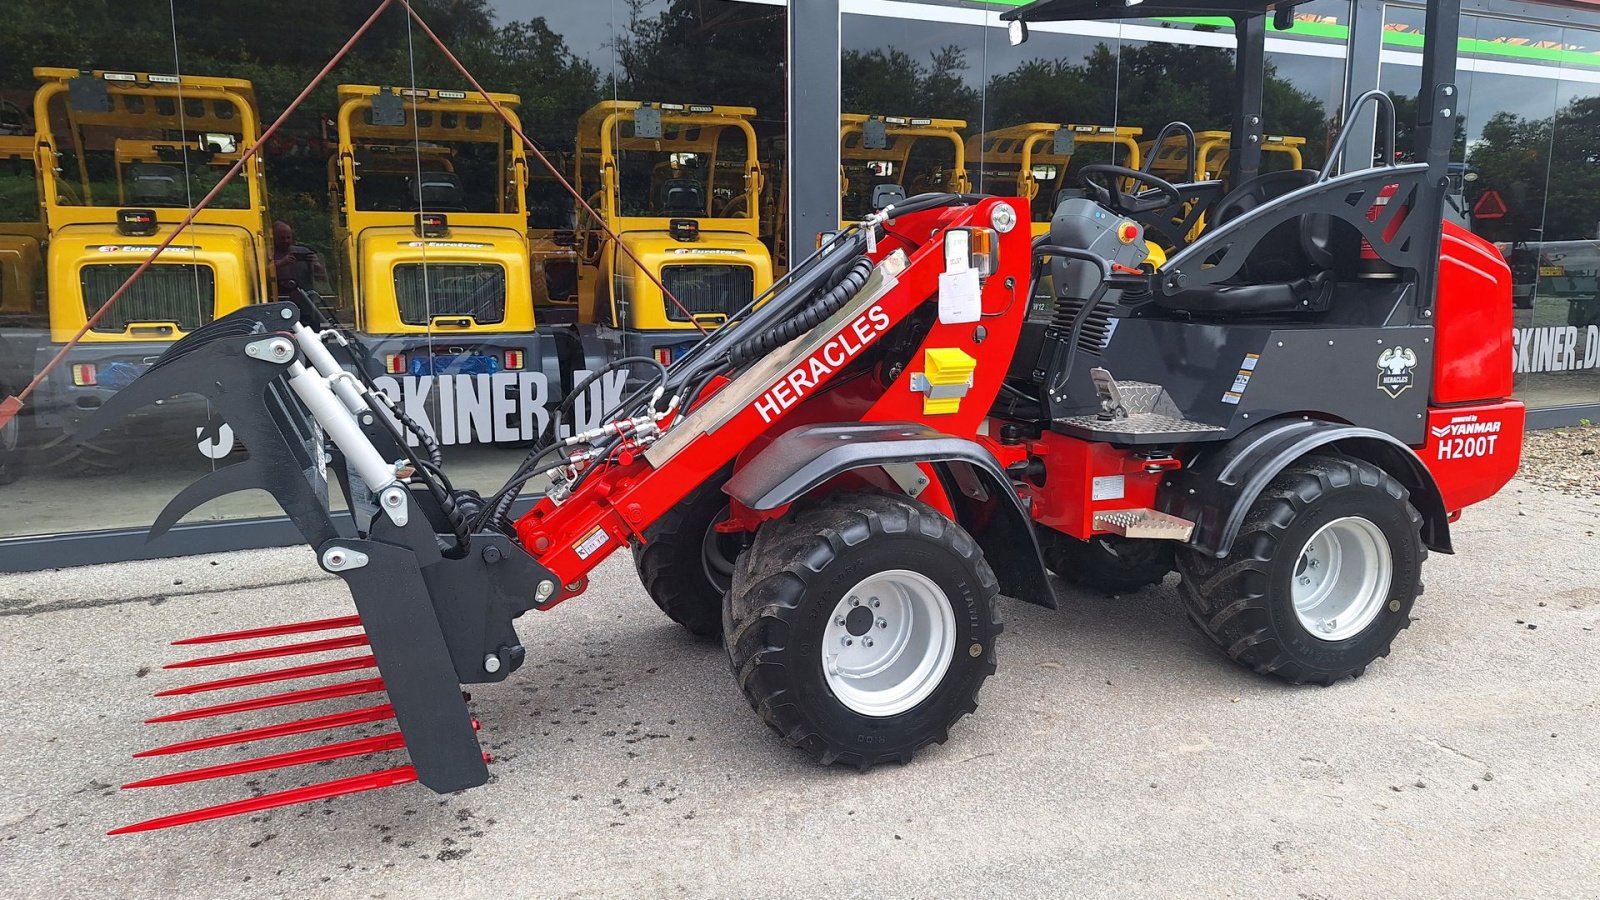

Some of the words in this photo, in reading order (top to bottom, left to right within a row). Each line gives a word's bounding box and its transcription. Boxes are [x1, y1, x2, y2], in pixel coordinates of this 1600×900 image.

[754, 305, 890, 423] HERACLES
[1383, 376, 1409, 384] HERACLES
[1450, 421, 1502, 435] YANMAR
[1437, 434, 1499, 460] H200T
